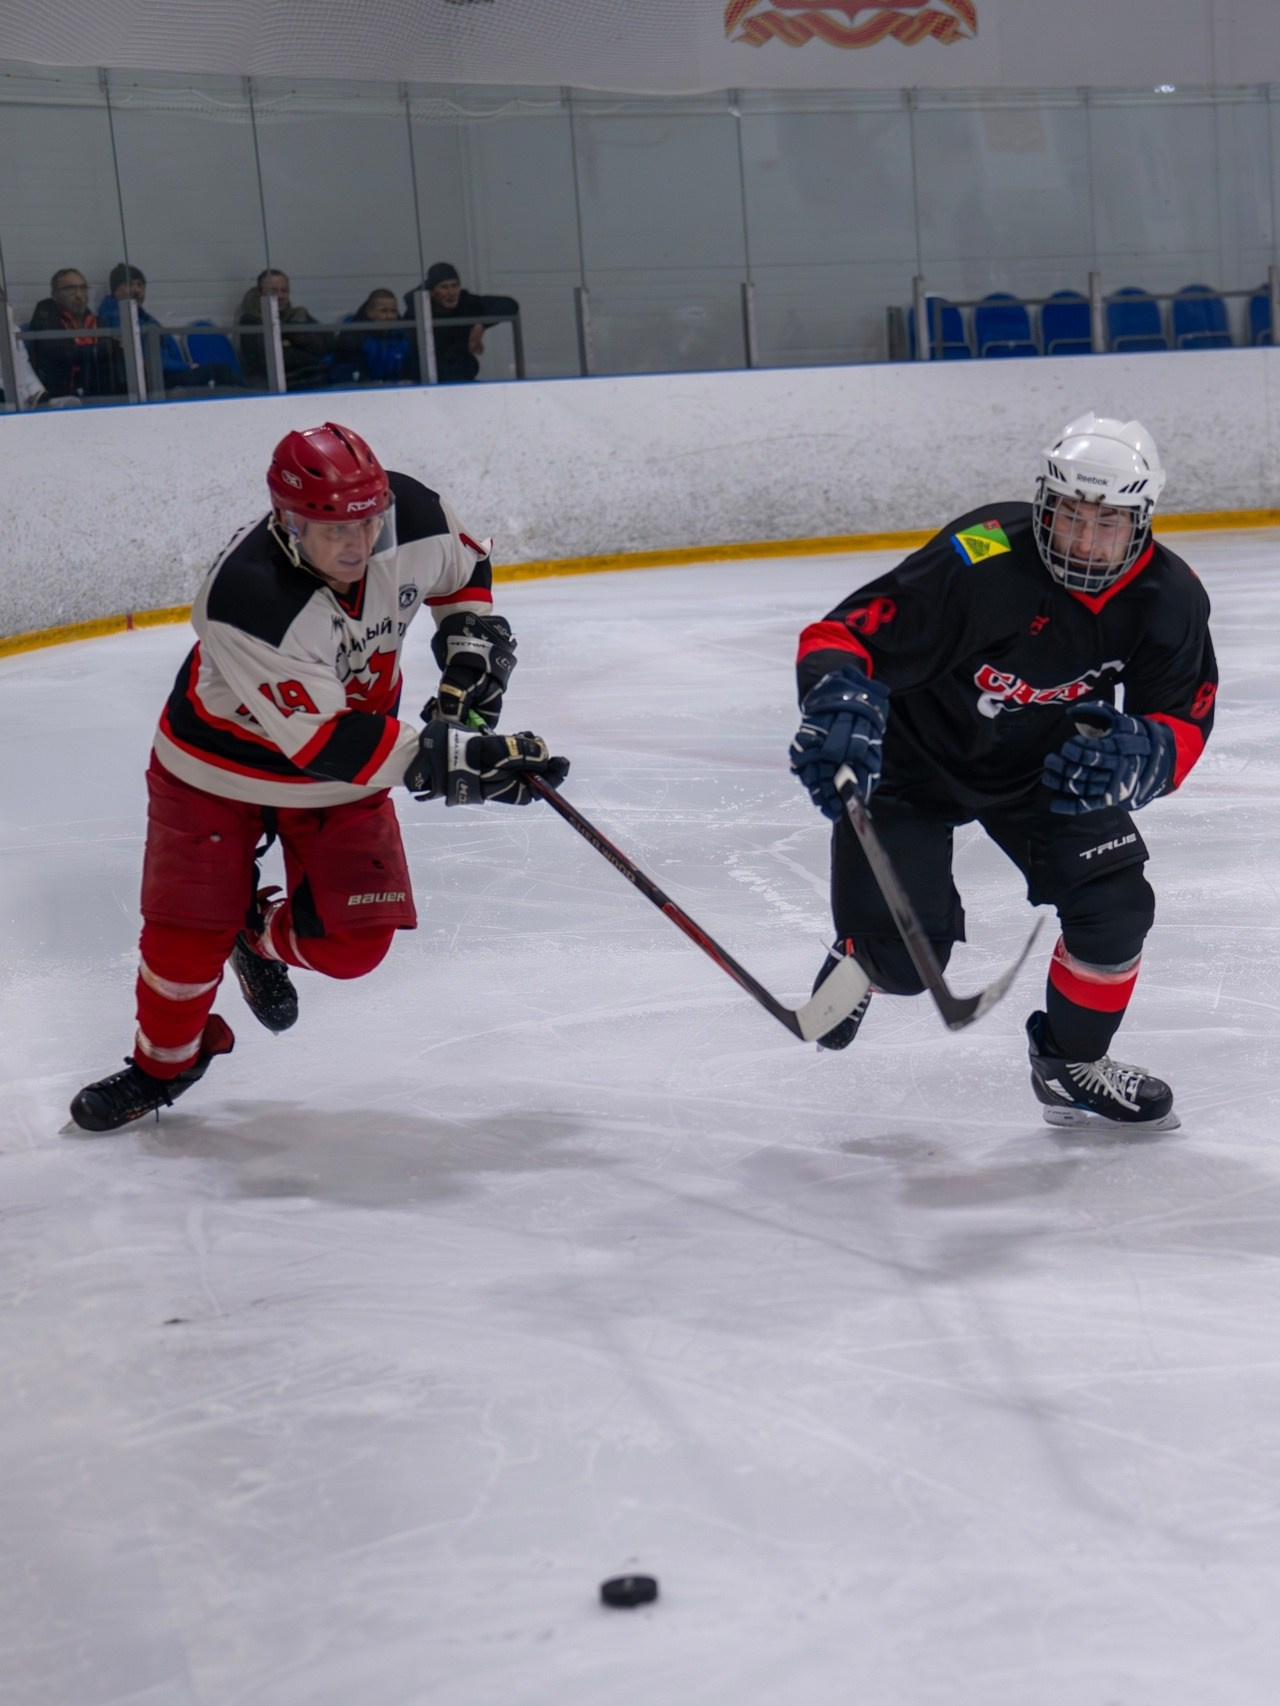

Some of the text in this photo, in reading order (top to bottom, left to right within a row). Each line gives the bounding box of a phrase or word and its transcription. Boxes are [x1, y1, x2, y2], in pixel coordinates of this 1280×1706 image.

[1076, 473, 1109, 487] Reebok
[257, 678, 321, 719] 19
[1079, 833, 1137, 860] TRUE
[347, 891, 406, 906] BAUER
